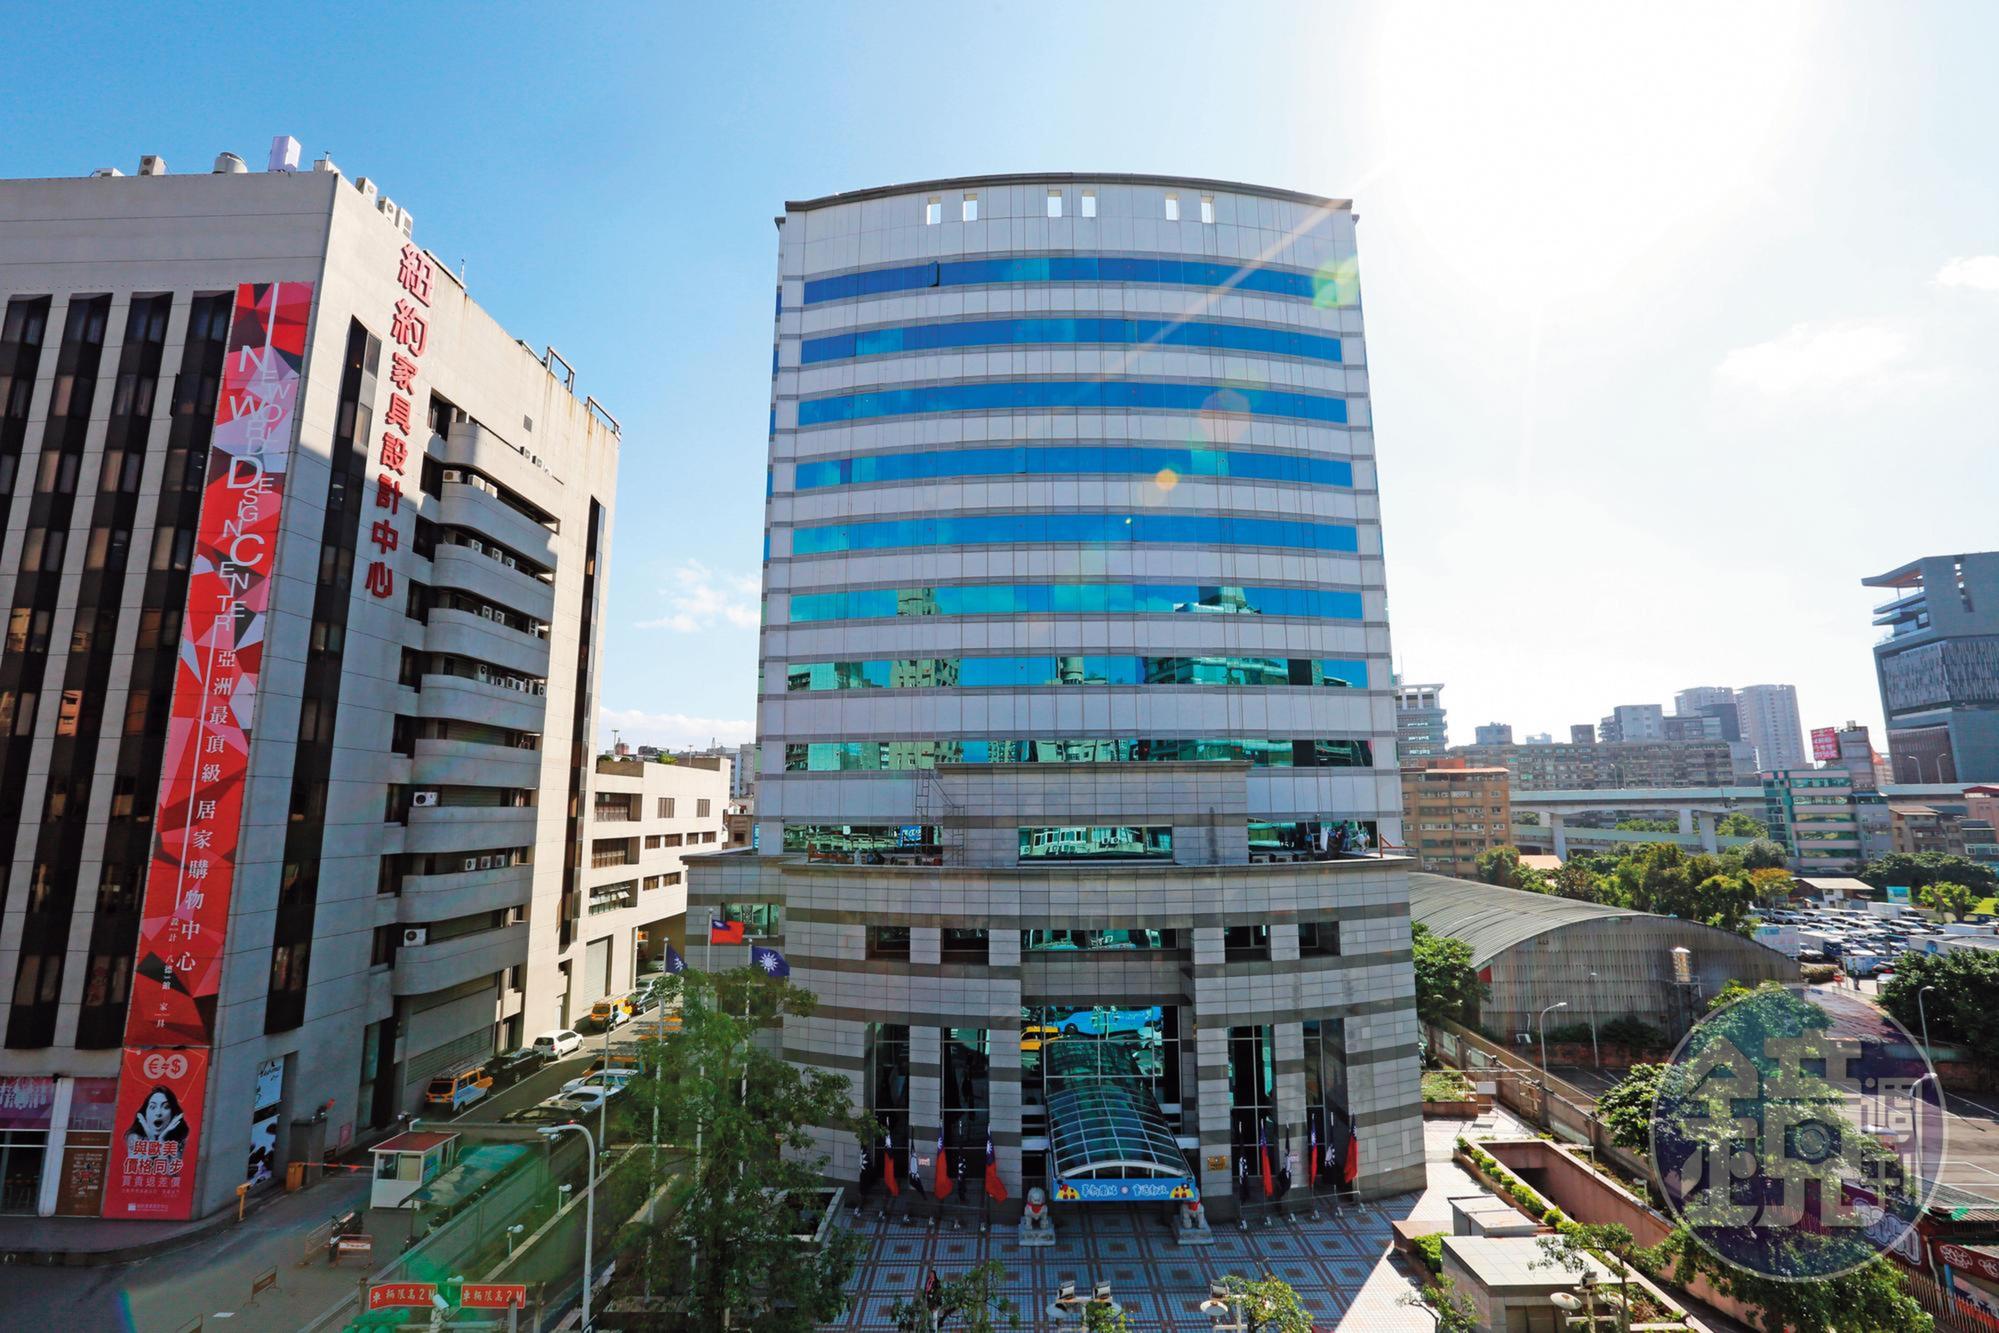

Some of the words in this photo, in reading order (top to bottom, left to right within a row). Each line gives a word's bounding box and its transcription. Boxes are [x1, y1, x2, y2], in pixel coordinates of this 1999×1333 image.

[365, 242, 437, 598] 紐約家具設計中心
[176, 650, 237, 972] 亞洲最頂級居家購物中心
[123, 1157, 183, 1176] 價格同步
[133, 1140, 179, 1157] 與歐美
